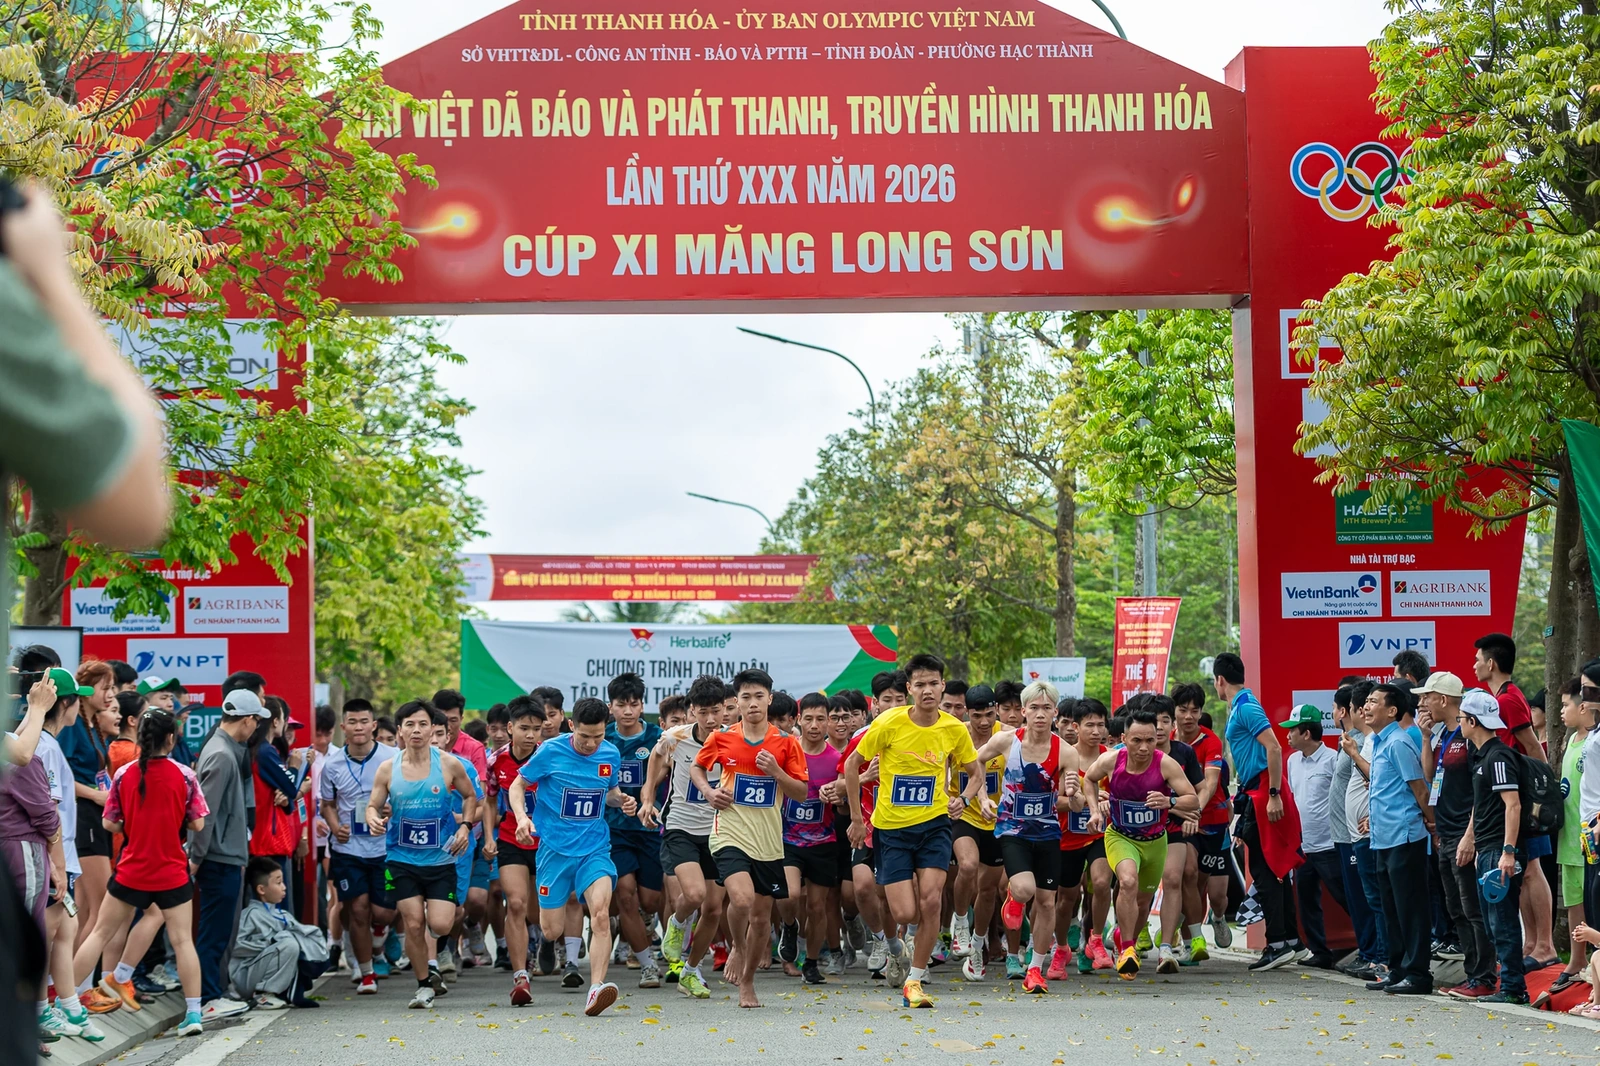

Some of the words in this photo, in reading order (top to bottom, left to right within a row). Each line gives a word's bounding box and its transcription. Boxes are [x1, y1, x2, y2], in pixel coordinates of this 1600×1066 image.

[520, 10, 578, 31] TỈNH
[582, 14, 664, 30] THANH
[669, 9, 718, 30] HÓA
[735, 8, 766, 30] ỦY
[772, 12, 818, 30] BAN
[823, 12, 924, 30] OLYMPIC
[927, 7, 980, 32] VIỆT
[984, 10, 1035, 28] NAM
[462, 46, 484, 62] SỞ
[487, 47, 563, 62] VHTT&DL
[576, 44, 620, 62] CÔNG
[624, 48, 646, 62] AN
[650, 44, 690, 62] TỈNH
[704, 44, 736, 61] BÁO
[739, 42, 762, 60] VÀ
[766, 47, 808, 60] PTTH
[825, 43, 865, 60] TỈNH
[870, 42, 915, 60] ĐOÀN
[928, 42, 996, 60] PHƯỜNG
[1000, 44, 1032, 62] HẠC
[1036, 41, 1094, 58] THÀNH
[412, 90, 473, 146] VIỆT
[482, 90, 522, 137] DÃ
[532, 90, 590, 138] BÁO
[600, 89, 639, 137] VÀ
[648, 88, 722, 136] PHÁT
[732, 95, 838, 141] THANH,
[847, 82, 960, 135] TRUYỀN
[970, 86, 1039, 133] HÌNH
[1049, 92, 1144, 132] THANH
[1154, 84, 1212, 131] HÓA
[606, 152, 664, 206] LẦN
[673, 157, 732, 205] THỨ
[738, 165, 798, 205] XXX
[807, 156, 875, 204] NĂM
[885, 163, 956, 203] 2026
[503, 226, 596, 277] CÚP
[612, 234, 658, 276] XI
[675, 224, 815, 275] MĂNG
[832, 230, 952, 274] LONG
[968, 225, 1064, 272] SƠN
[1350, 553, 1366, 564] NHÀ
[1369, 553, 1381, 564] TÀI
[1382, 554, 1398, 565] TRỢ
[1400, 554, 1415, 565] BẠC
[1286, 586, 1360, 599] VietinBank
[1410, 582, 1487, 594] AGRIBANK
[204, 599, 285, 610] AGRIBANK
[670, 636, 726, 649] Herbalife
[1370, 638, 1432, 650] VNPT
[159, 655, 224, 668] VNPT
[587, 658, 645, 678] CHƯƠNG
[649, 657, 692, 678] TRÌNH
[697, 658, 738, 678] TOÀN
[744, 787, 765, 803] 28
[898, 786, 928, 802] 118
[574, 801, 593, 816] 10
[796, 807, 814, 820] 99
[1024, 803, 1044, 816] 68
[1125, 810, 1154, 824] 100
[409, 830, 429, 845] 43
[1202, 854, 1225, 870] 092
